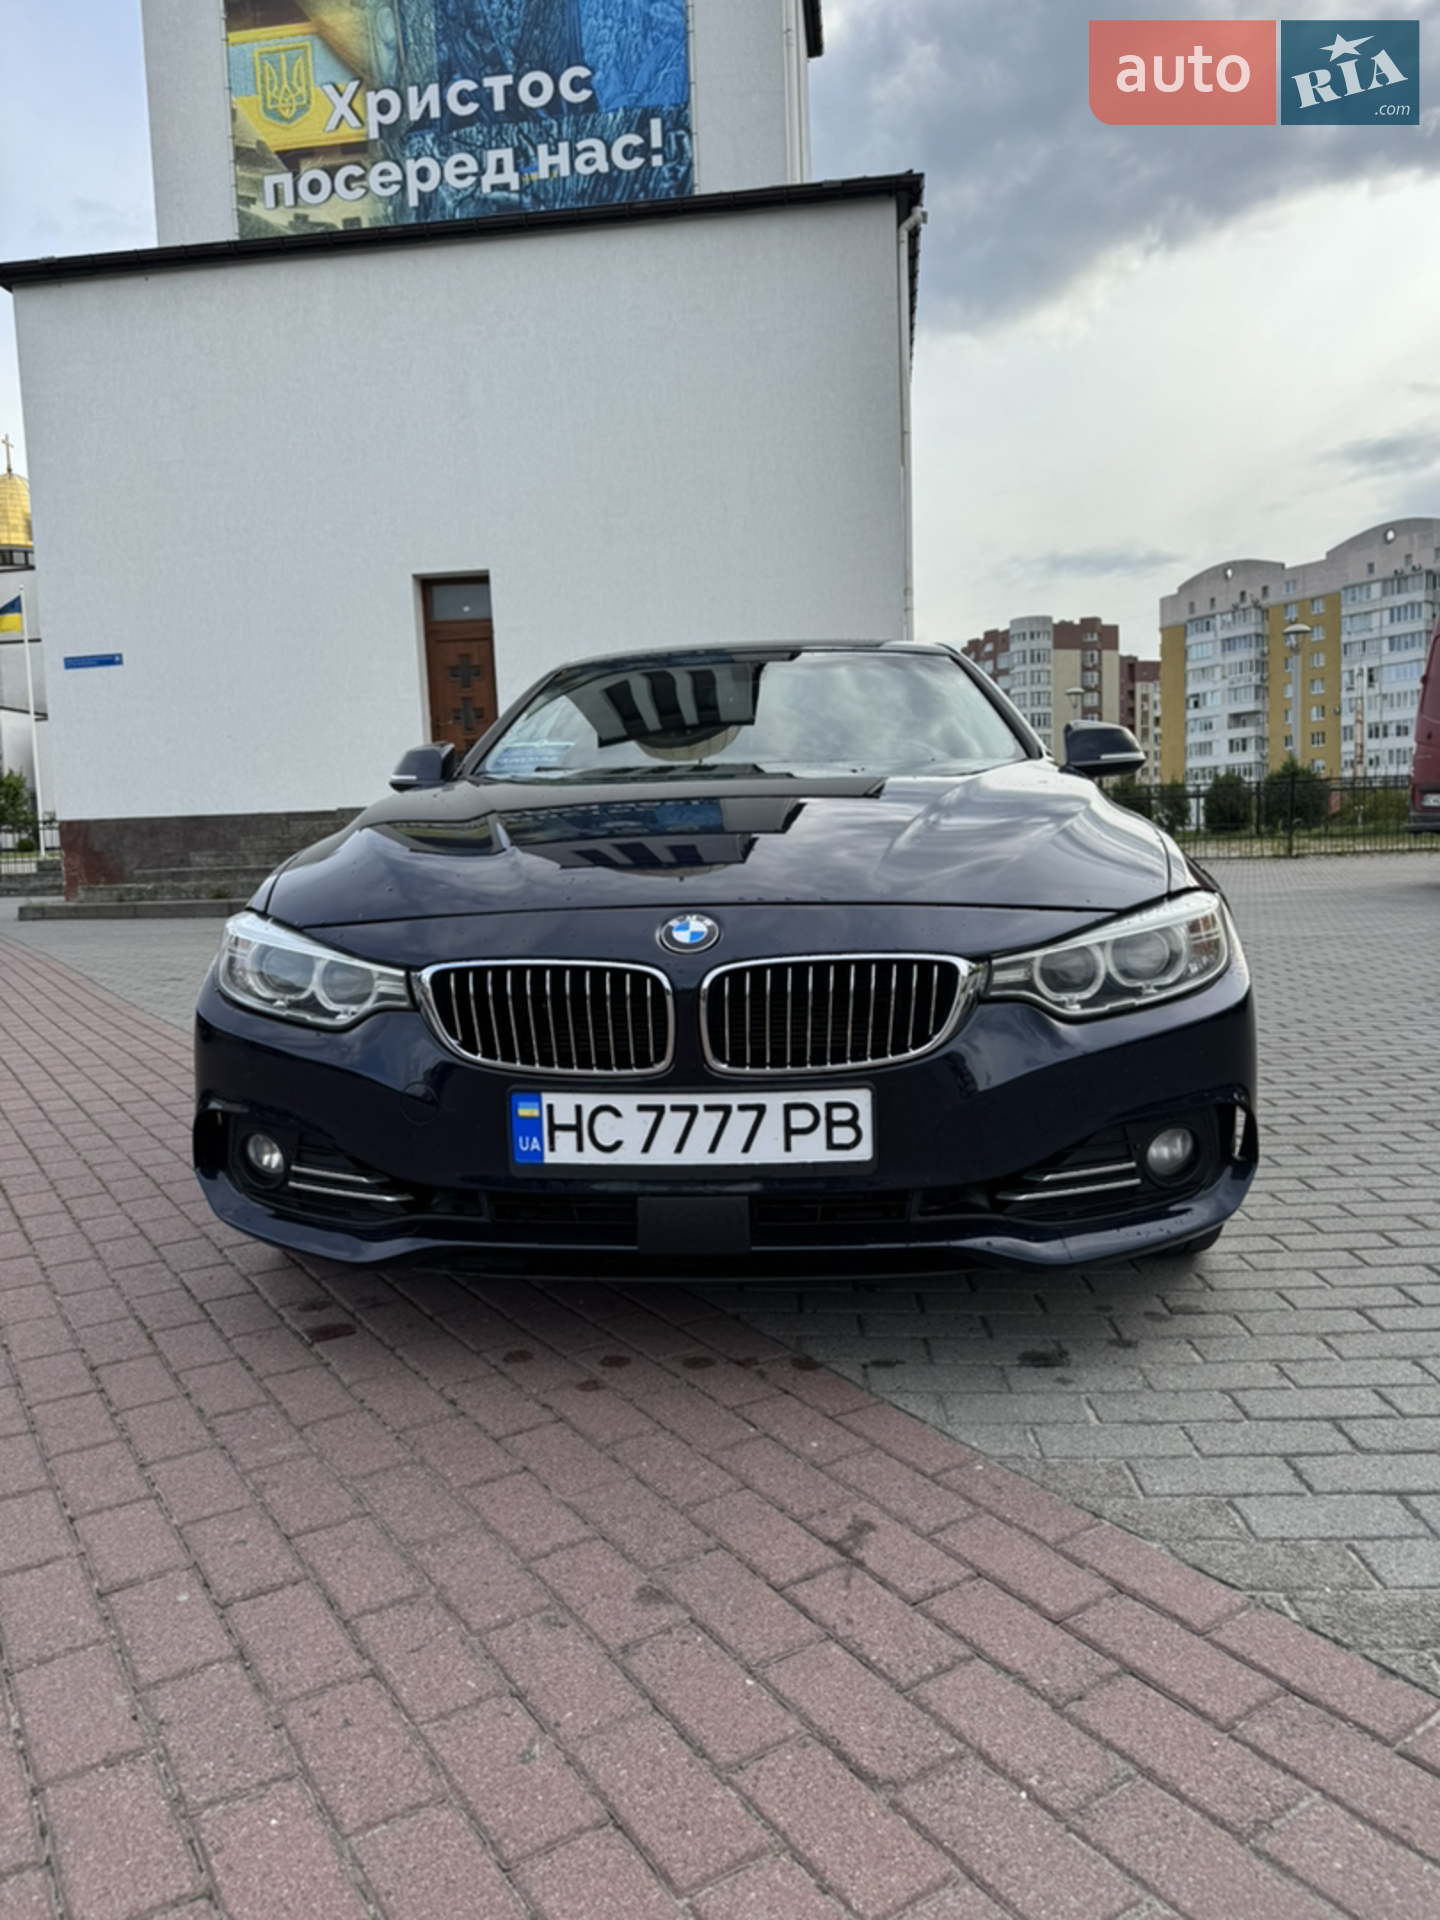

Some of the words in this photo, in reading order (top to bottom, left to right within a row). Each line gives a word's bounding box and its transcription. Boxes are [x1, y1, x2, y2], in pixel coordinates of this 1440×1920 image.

[322, 64, 594, 141] Христос
[262, 146, 520, 210] посеред
[536, 117, 665, 180] нас!
[518, 1136, 541, 1152] UA
[546, 1103, 624, 1154] HC
[636, 1104, 767, 1154] 7777
[783, 1101, 864, 1153] PB
